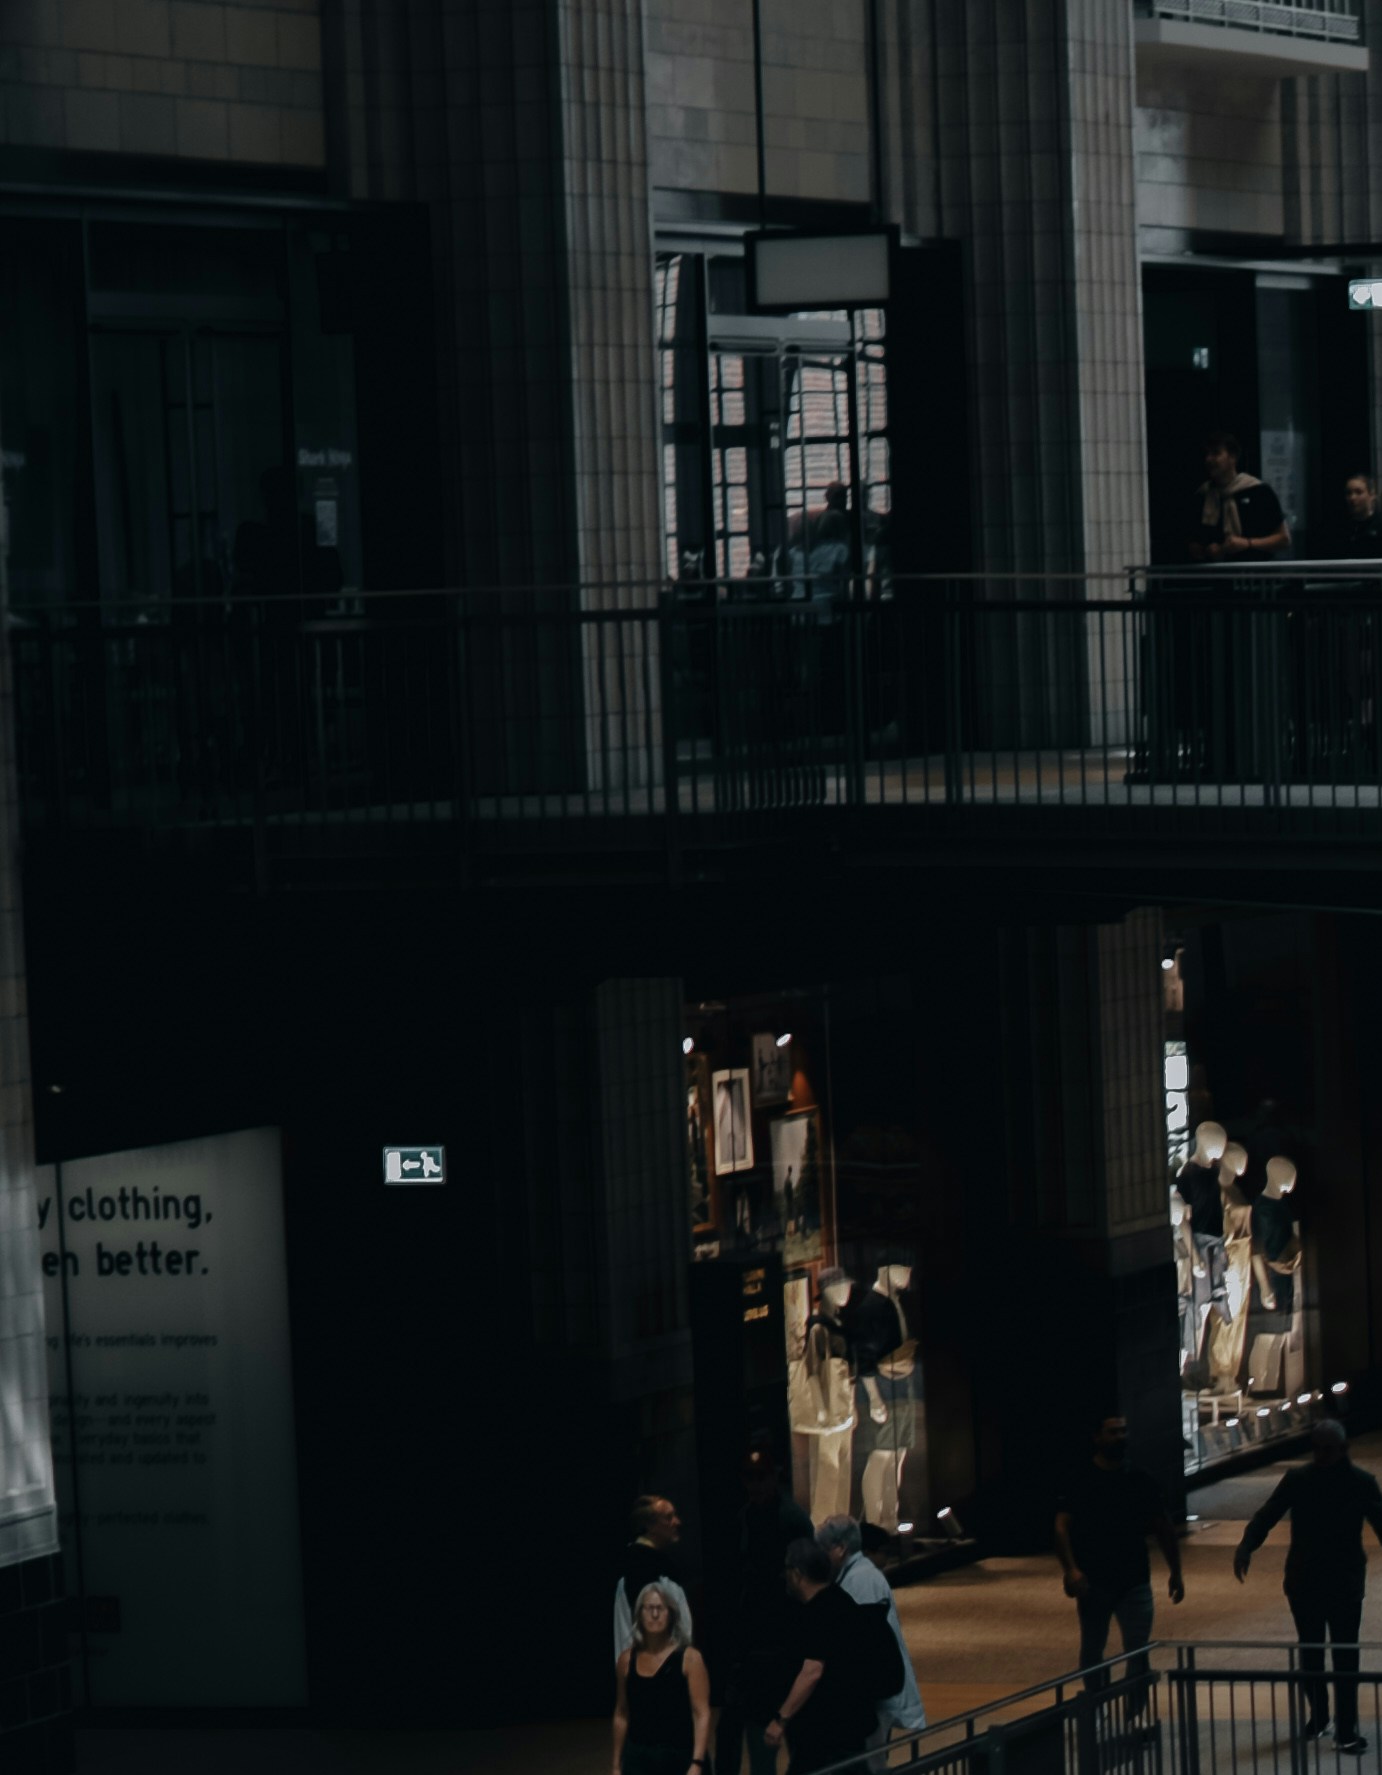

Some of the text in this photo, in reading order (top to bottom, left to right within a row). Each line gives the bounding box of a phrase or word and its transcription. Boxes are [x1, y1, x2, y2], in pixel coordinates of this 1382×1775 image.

[68, 1186, 212, 1230] clothing,
[96, 1241, 209, 1278] better.
[95, 1333, 155, 1347] essentials
[160, 1333, 217, 1351] improves
